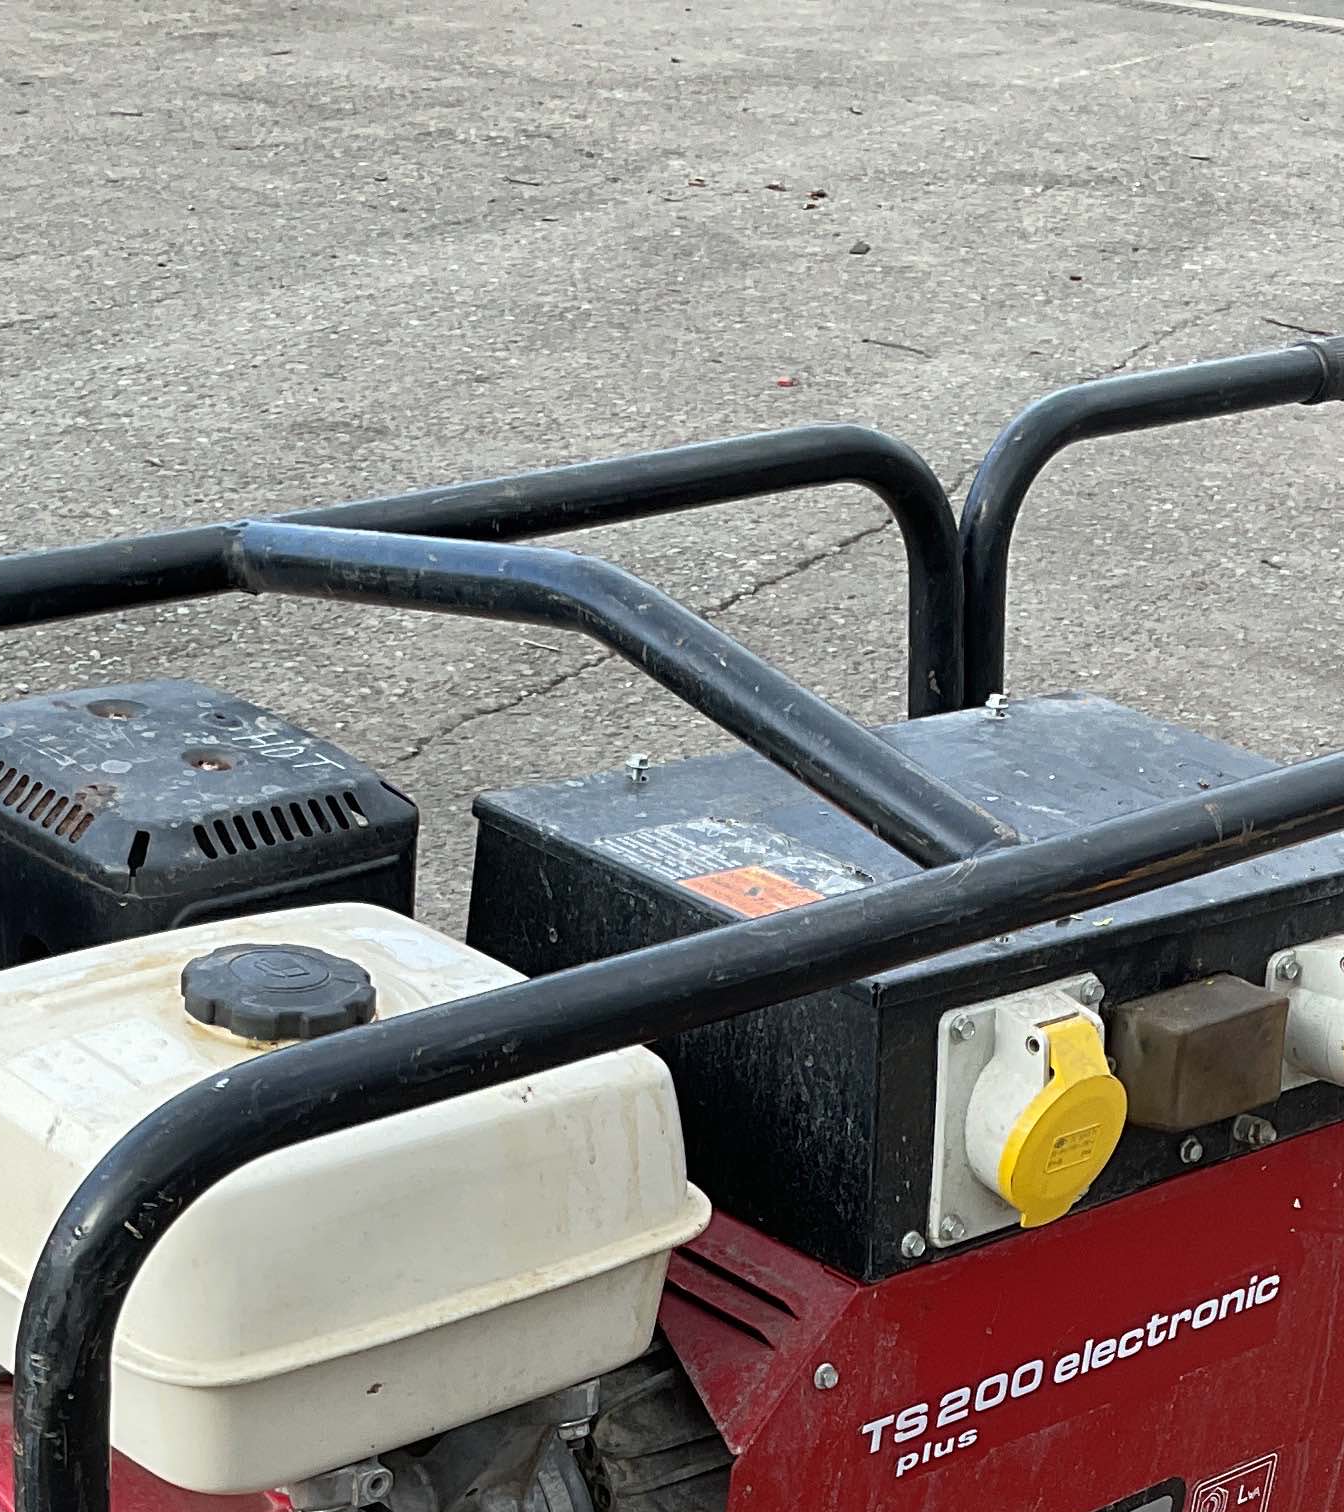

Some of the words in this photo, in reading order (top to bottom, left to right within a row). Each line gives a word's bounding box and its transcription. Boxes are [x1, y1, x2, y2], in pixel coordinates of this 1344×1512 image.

[232, 732, 346, 770] HOT
[862, 1402, 929, 1455] TS
[935, 1359, 1045, 1430] 200
[1052, 1273, 1282, 1385] electronic
[895, 1428, 979, 1478] plus
